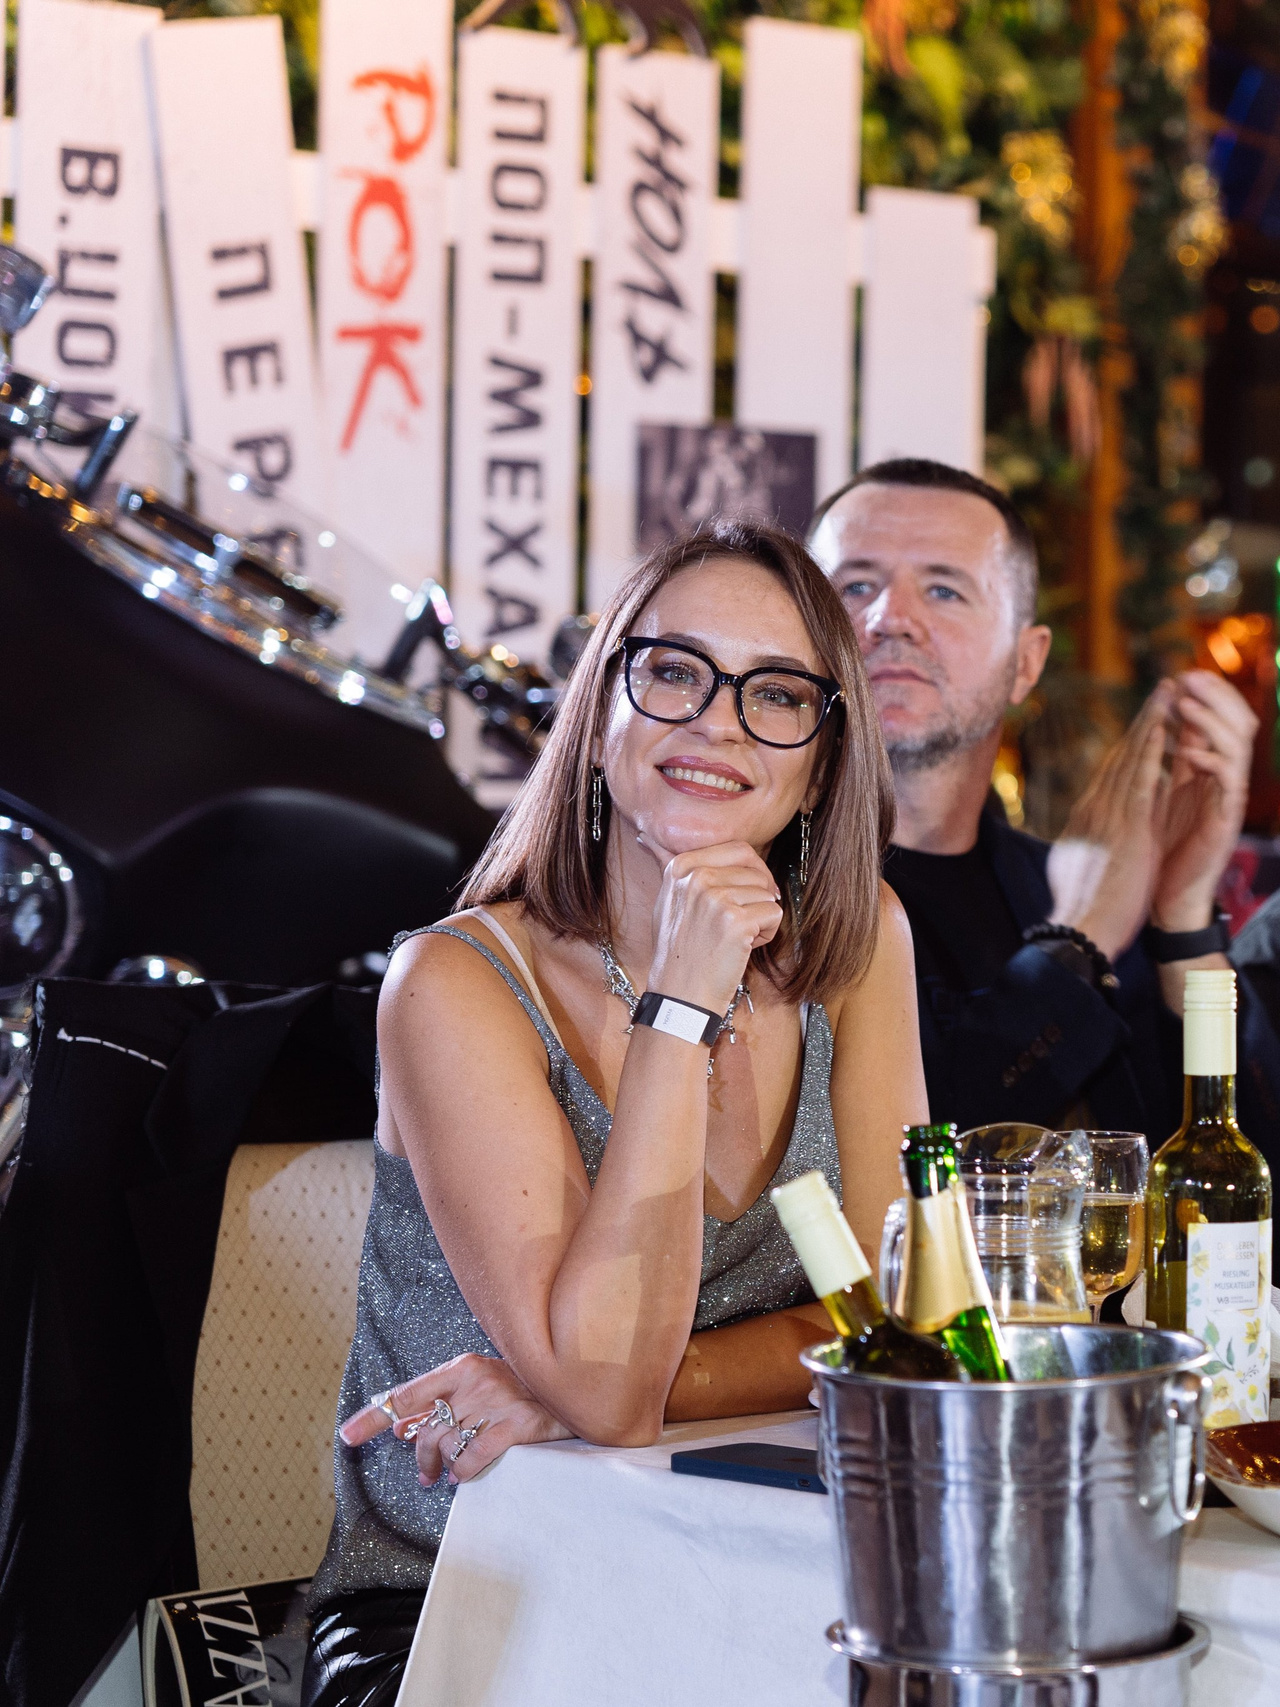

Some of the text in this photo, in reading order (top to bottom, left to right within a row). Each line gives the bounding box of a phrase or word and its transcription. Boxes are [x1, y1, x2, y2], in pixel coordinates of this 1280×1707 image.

[337, 62, 436, 452] РОК
[620, 98, 692, 386] НОЛЬ
[1214, 1280, 1255, 1290] MUSKATELLER
[1222, 1269, 1250, 1278] RIESLING
